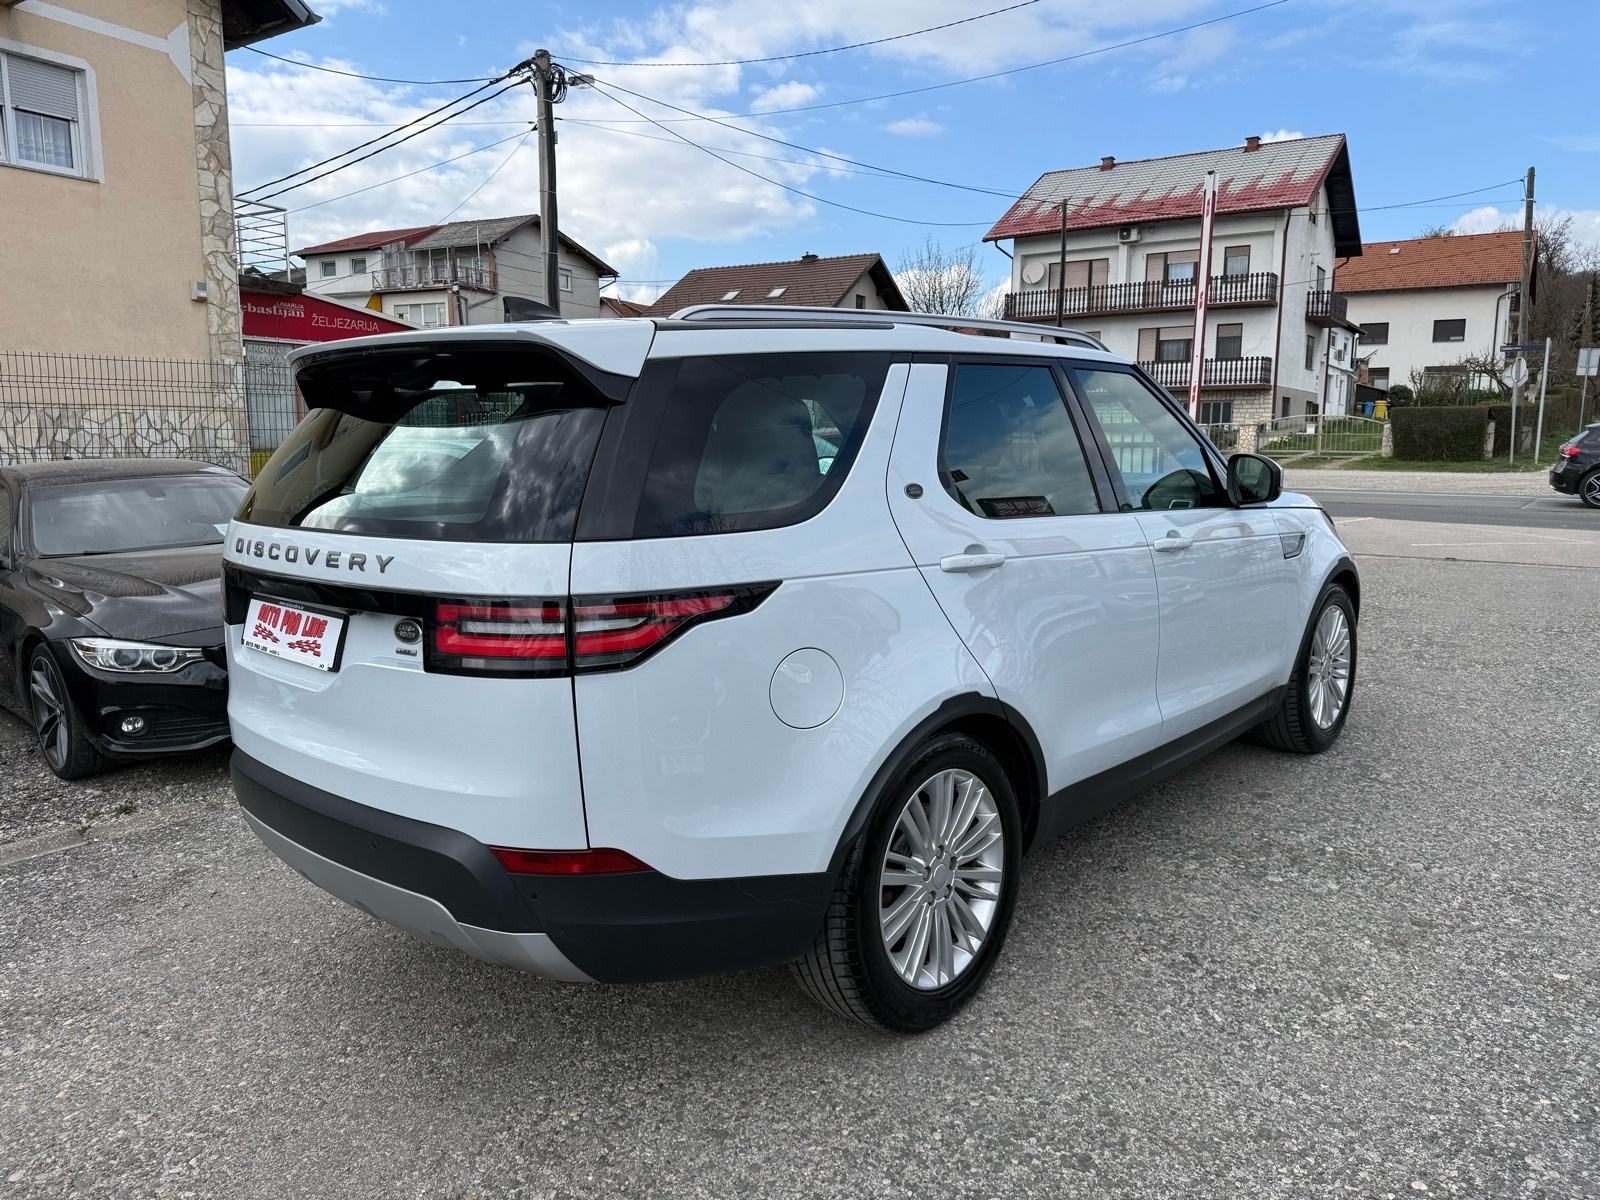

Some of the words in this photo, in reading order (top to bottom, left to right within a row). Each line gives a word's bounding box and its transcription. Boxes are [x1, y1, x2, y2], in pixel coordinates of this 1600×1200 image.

[240, 303, 304, 318] ebastijan
[311, 313, 379, 332] ŽELJEZARIJA
[235, 537, 395, 573] DISCOVERY
[257, 603, 281, 628] AUTO
[280, 610, 303, 635] PRO
